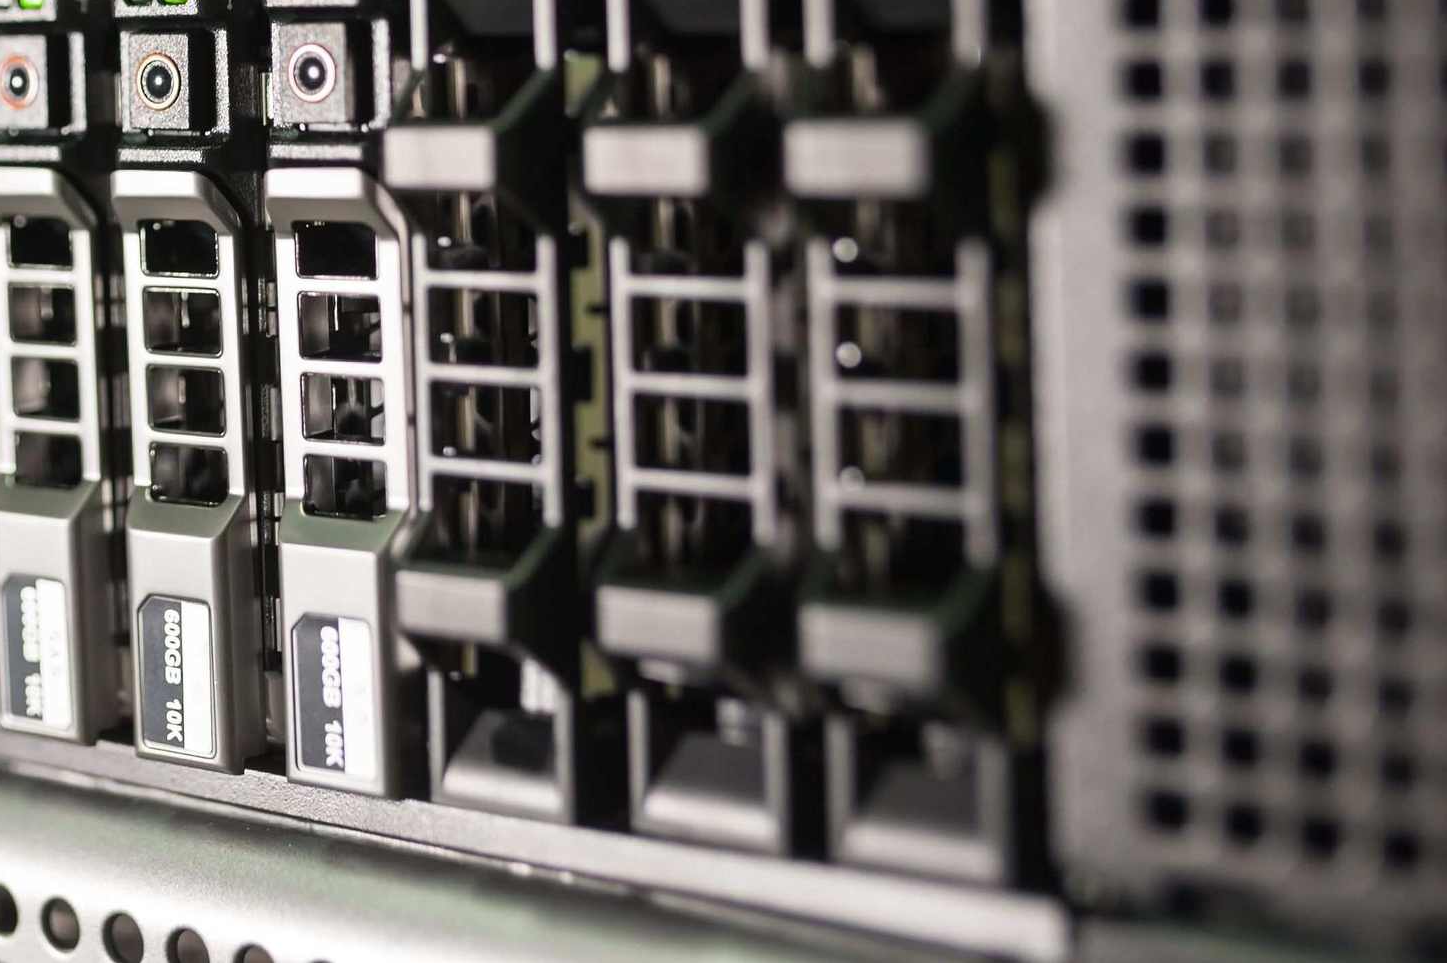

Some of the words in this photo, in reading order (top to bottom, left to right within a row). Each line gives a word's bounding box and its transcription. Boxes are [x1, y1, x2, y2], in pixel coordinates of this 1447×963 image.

[164, 609, 182, 686] 600GB
[166, 699, 183, 742] 10K
[324, 720, 345, 768] 10K
